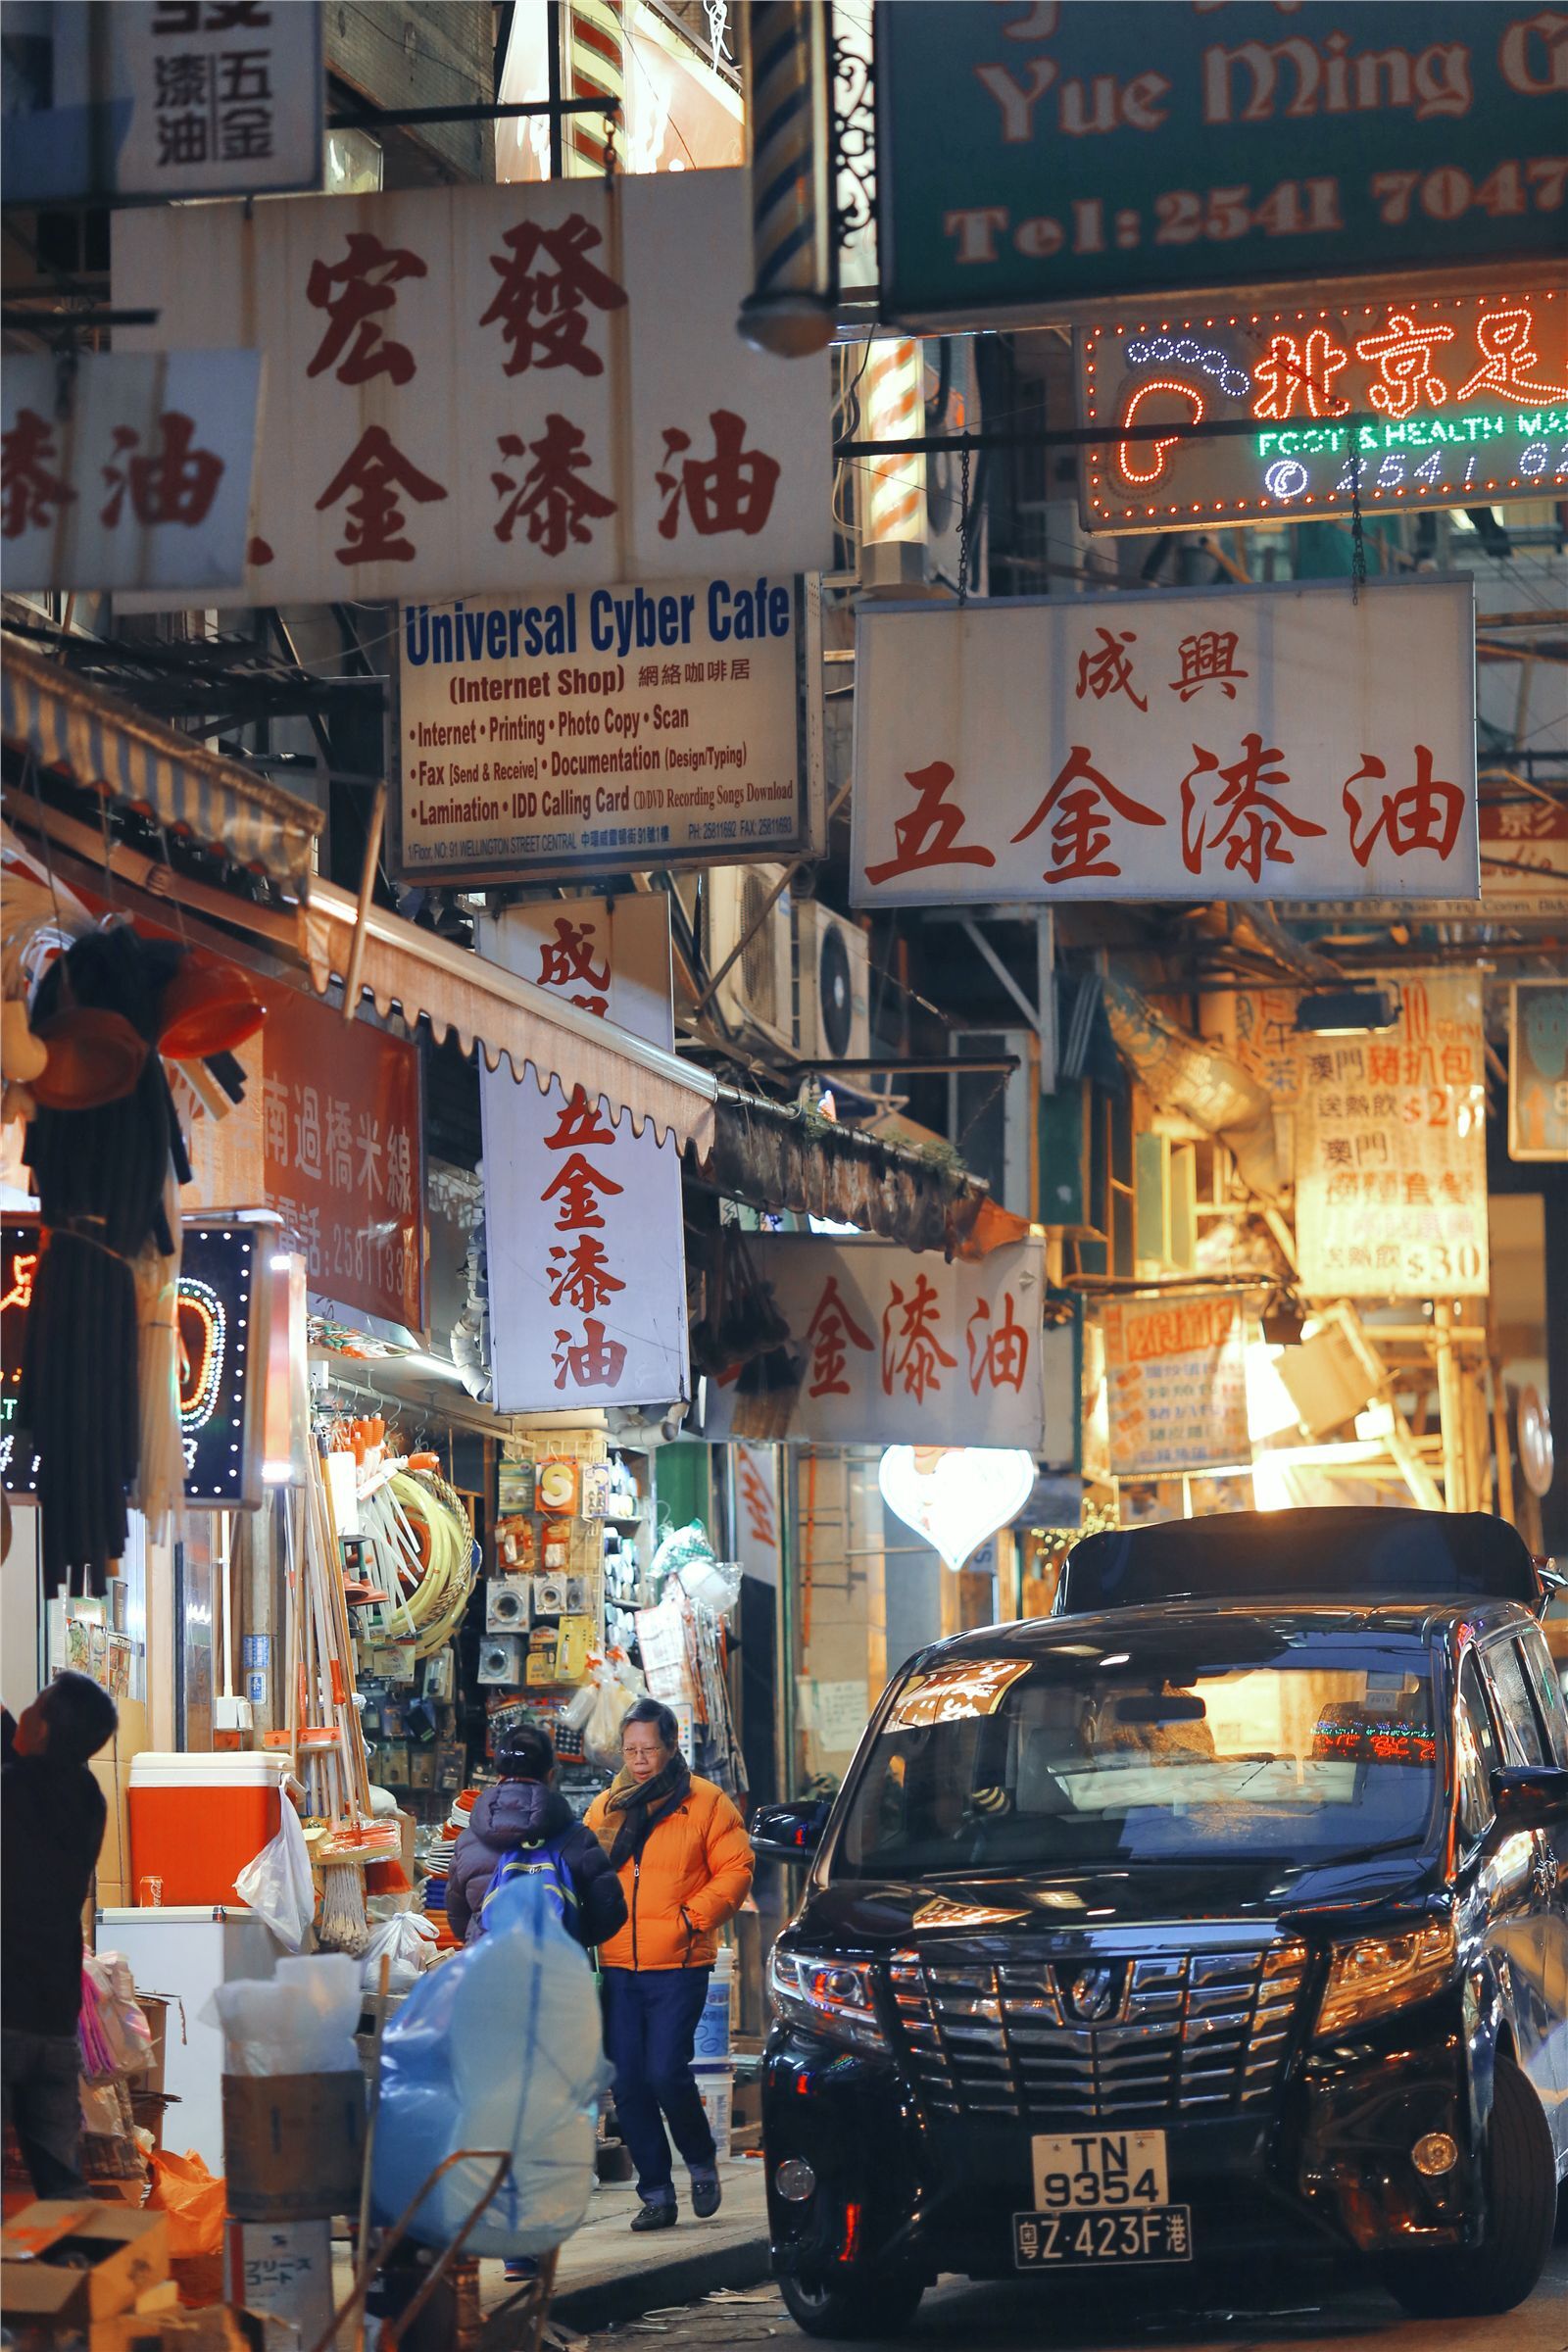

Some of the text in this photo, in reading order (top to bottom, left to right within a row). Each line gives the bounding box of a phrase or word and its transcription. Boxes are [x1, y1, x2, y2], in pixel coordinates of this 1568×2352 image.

[218, 50, 274, 162] 五金
[977, 57, 1171, 142] Yue
[1202, 30, 1471, 122] Ming
[1373, 157, 1568, 225] 7047
[306, 213, 628, 386] 宏發
[1385, 416, 1503, 447] HEALTH
[248, 410, 781, 565] 金漆油
[406, 576, 789, 666] Universal Cyber Cafe
[449, 664, 625, 705] (Internet Shop)
[638, 659, 750, 687] 網絡咖啡居
[1075, 628, 1248, 711] 成興
[418, 704, 689, 747] Internet Printing Photo Copy Scan
[418, 760, 444, 786] Fax
[482, 762, 490, 781] &
[552, 745, 661, 776] Documentation
[664, 741, 747, 771] (Design/Typing)
[419, 796, 499, 825] Lamination
[513, 792, 537, 818] IDD
[542, 789, 591, 820] Calling
[596, 785, 629, 813] Card
[666, 787, 714, 810] Recording
[716, 785, 745, 808] Songs
[747, 780, 793, 802] Download
[864, 733, 1466, 885] 五金漆油
[460, 837, 510, 858] WELLINGTON
[511, 835, 540, 855] STREET
[542, 833, 576, 852] CENTRAL
[540, 1085, 627, 1390] 五金漆油
[716, 1273, 1028, 1405] 金漆油
[1044, 2169, 1159, 2207] 9354
[1071, 2136, 1127, 2172] TN
